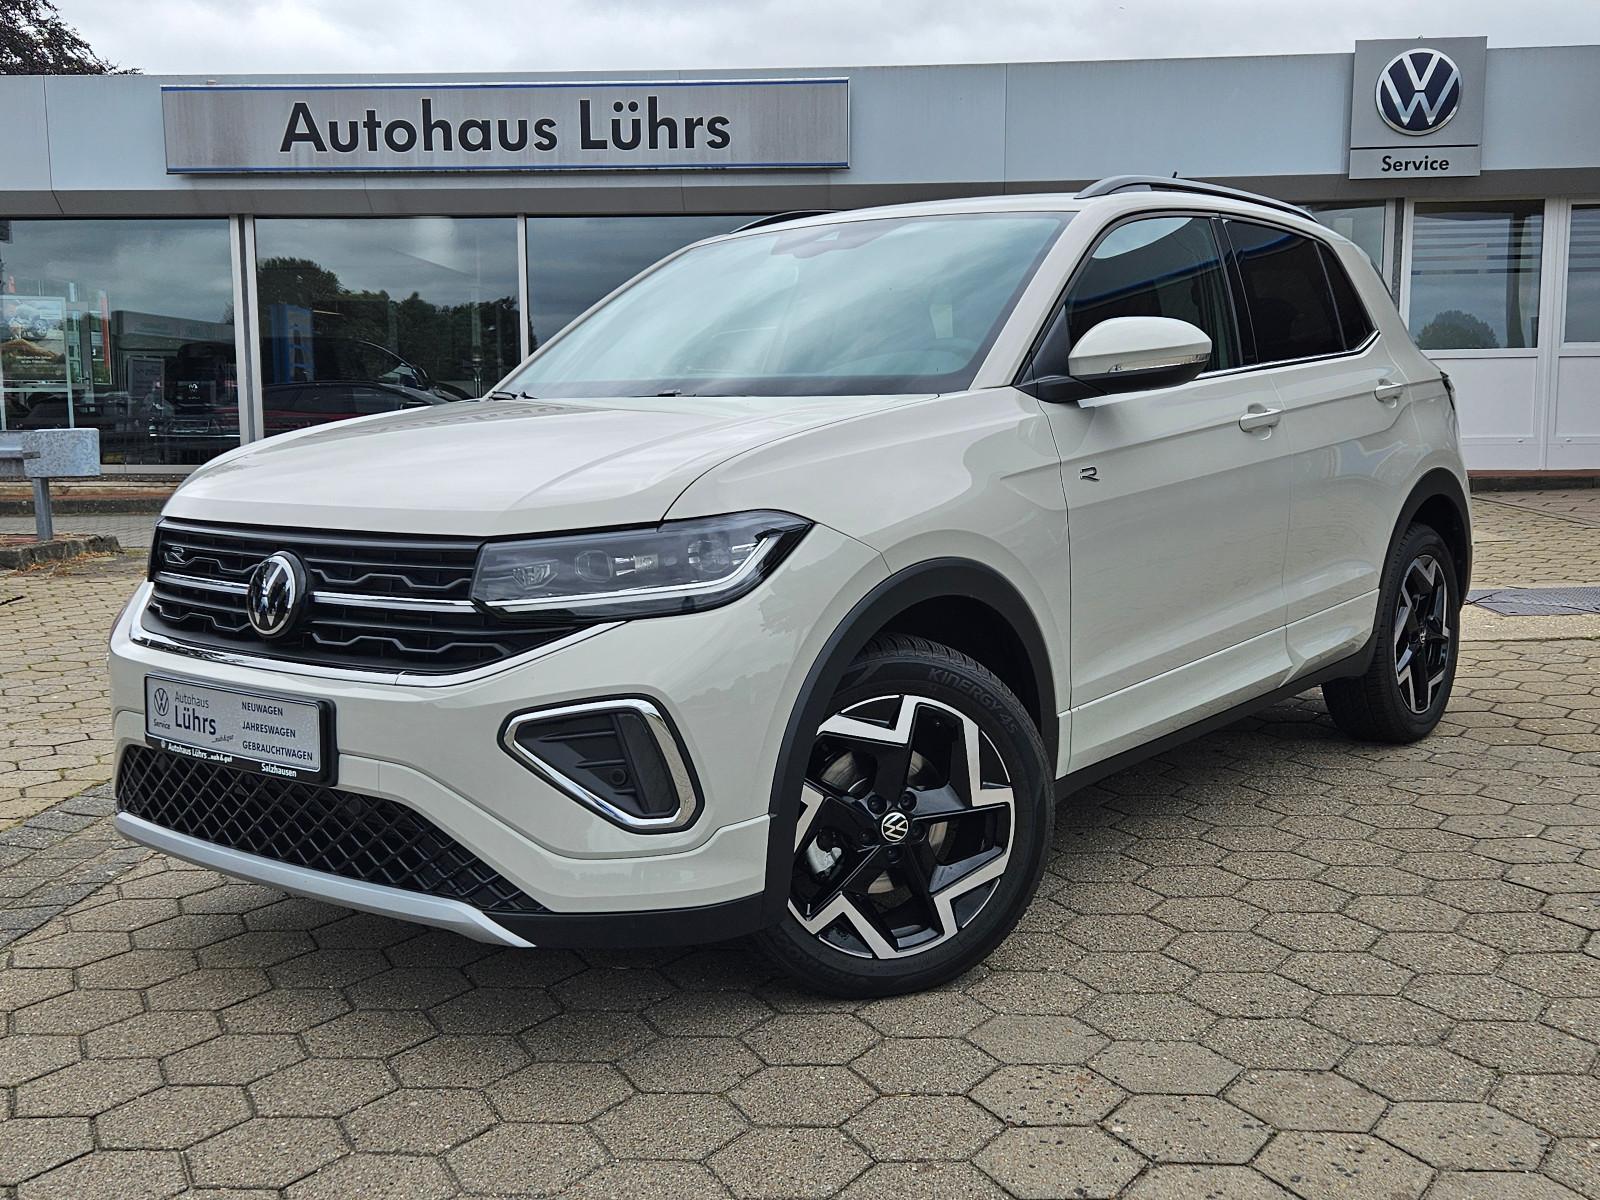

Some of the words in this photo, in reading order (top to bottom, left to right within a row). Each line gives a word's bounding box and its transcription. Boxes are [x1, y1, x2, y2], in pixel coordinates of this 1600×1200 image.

[279, 98, 558, 152] Autohaus
[579, 95, 731, 150] Lührs
[1381, 155, 1450, 172] Service
[927, 667, 1003, 711] KINERGY
[175, 691, 209, 709] Autohaus
[241, 701, 283, 716] NEUWAGEN
[153, 718, 171, 730] Service
[175, 705, 216, 736] Lührs
[242, 721, 296, 738] JAHRESWAGEN
[167, 743, 192, 756] Autohaus
[192, 748, 207, 759] Lührs
[242, 740, 313, 761] GEBRAUCHTWAGEN
[261, 762, 297, 778] Salzhausen
